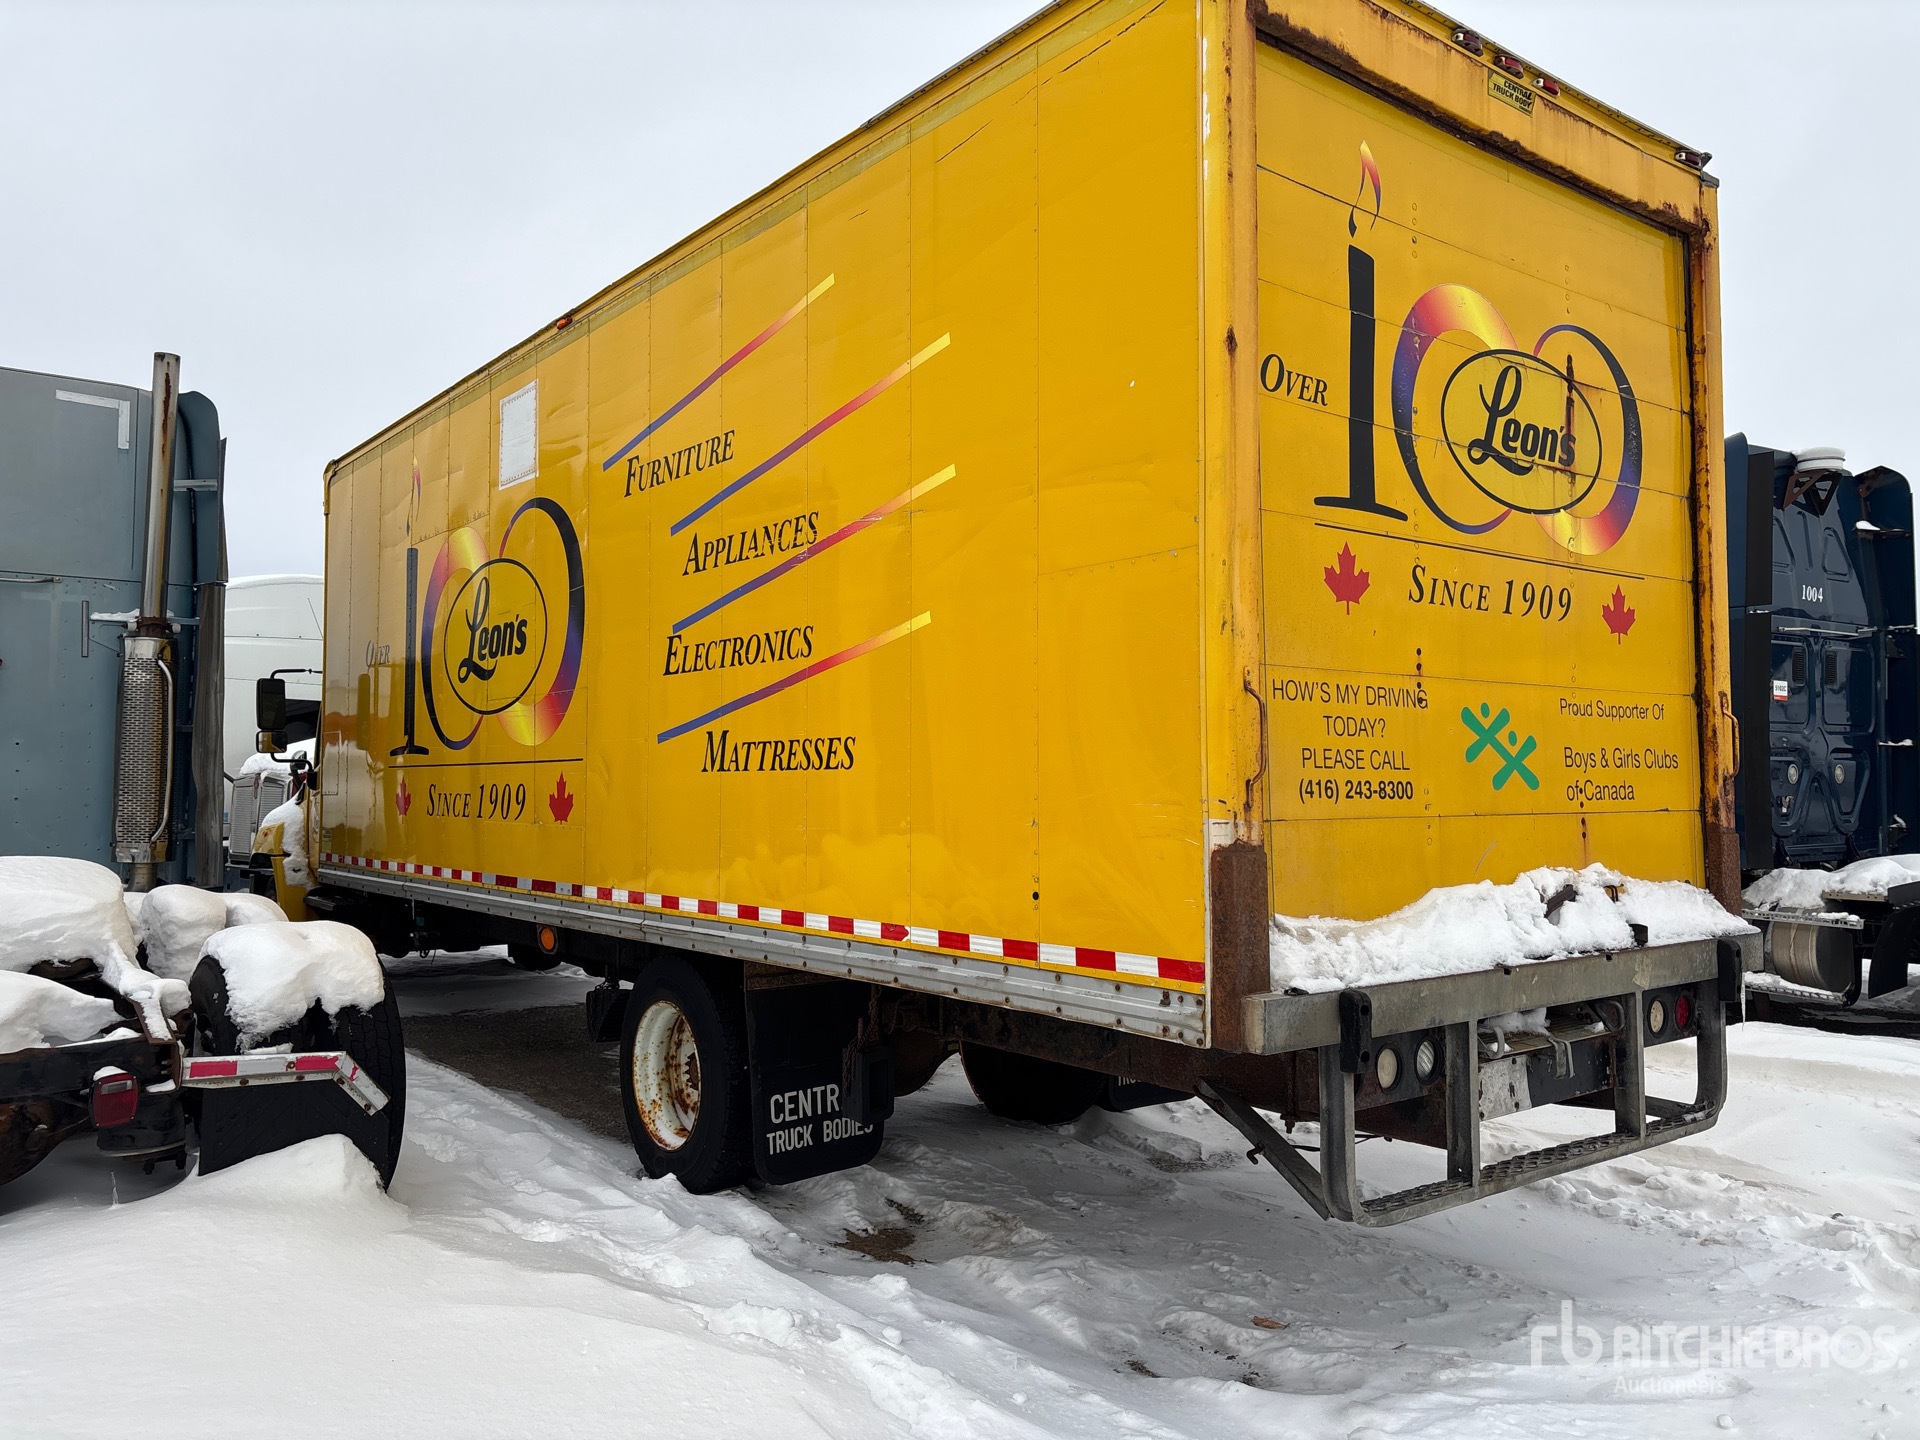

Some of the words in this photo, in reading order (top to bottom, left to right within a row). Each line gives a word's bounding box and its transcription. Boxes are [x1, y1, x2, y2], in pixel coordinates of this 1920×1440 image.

[1493, 82, 1514, 101] TRUCK
[1514, 95, 1533, 109] BODY
[1503, 80, 1533, 101] CENTRAL
[1468, 365, 1577, 476] Leon's
[624, 430, 735, 497] FURNITURE
[682, 511, 819, 576] APPLIANCES
[1408, 563, 1490, 612] SINCE
[1501, 578, 1573, 623] 1909
[1802, 584, 1824, 603] 1004
[457, 577, 528, 683] Leon's
[662, 625, 814, 676] ELECTRONICS
[1272, 678, 1331, 703] HOW'S
[1336, 683, 1361, 705] MY
[1365, 685, 1429, 709] DRIVING
[1559, 698, 1593, 717] Proud
[1596, 700, 1650, 722] Supporter
[1652, 703, 1665, 721] Of
[1322, 715, 1386, 738] TODAY?
[701, 729, 856, 773] MATTRESSES
[1301, 747, 1366, 770] PLEASE
[1369, 749, 1411, 771] CALL
[1564, 746, 1597, 774] Boys
[1600, 747, 1610, 769] &
[1612, 747, 1641, 769] Girls
[1644, 748, 1679, 770] Clubs
[426, 783, 472, 818] SINCE
[476, 783, 527, 821] 1909
[1299, 778, 1340, 804] (416)
[1344, 780, 1414, 800] 243-8300
[1566, 780, 1580, 801] of
[1583, 779, 1635, 801] Canada
[769, 1083, 842, 1125] CENTR
[766, 1123, 814, 1156] TRUCK
